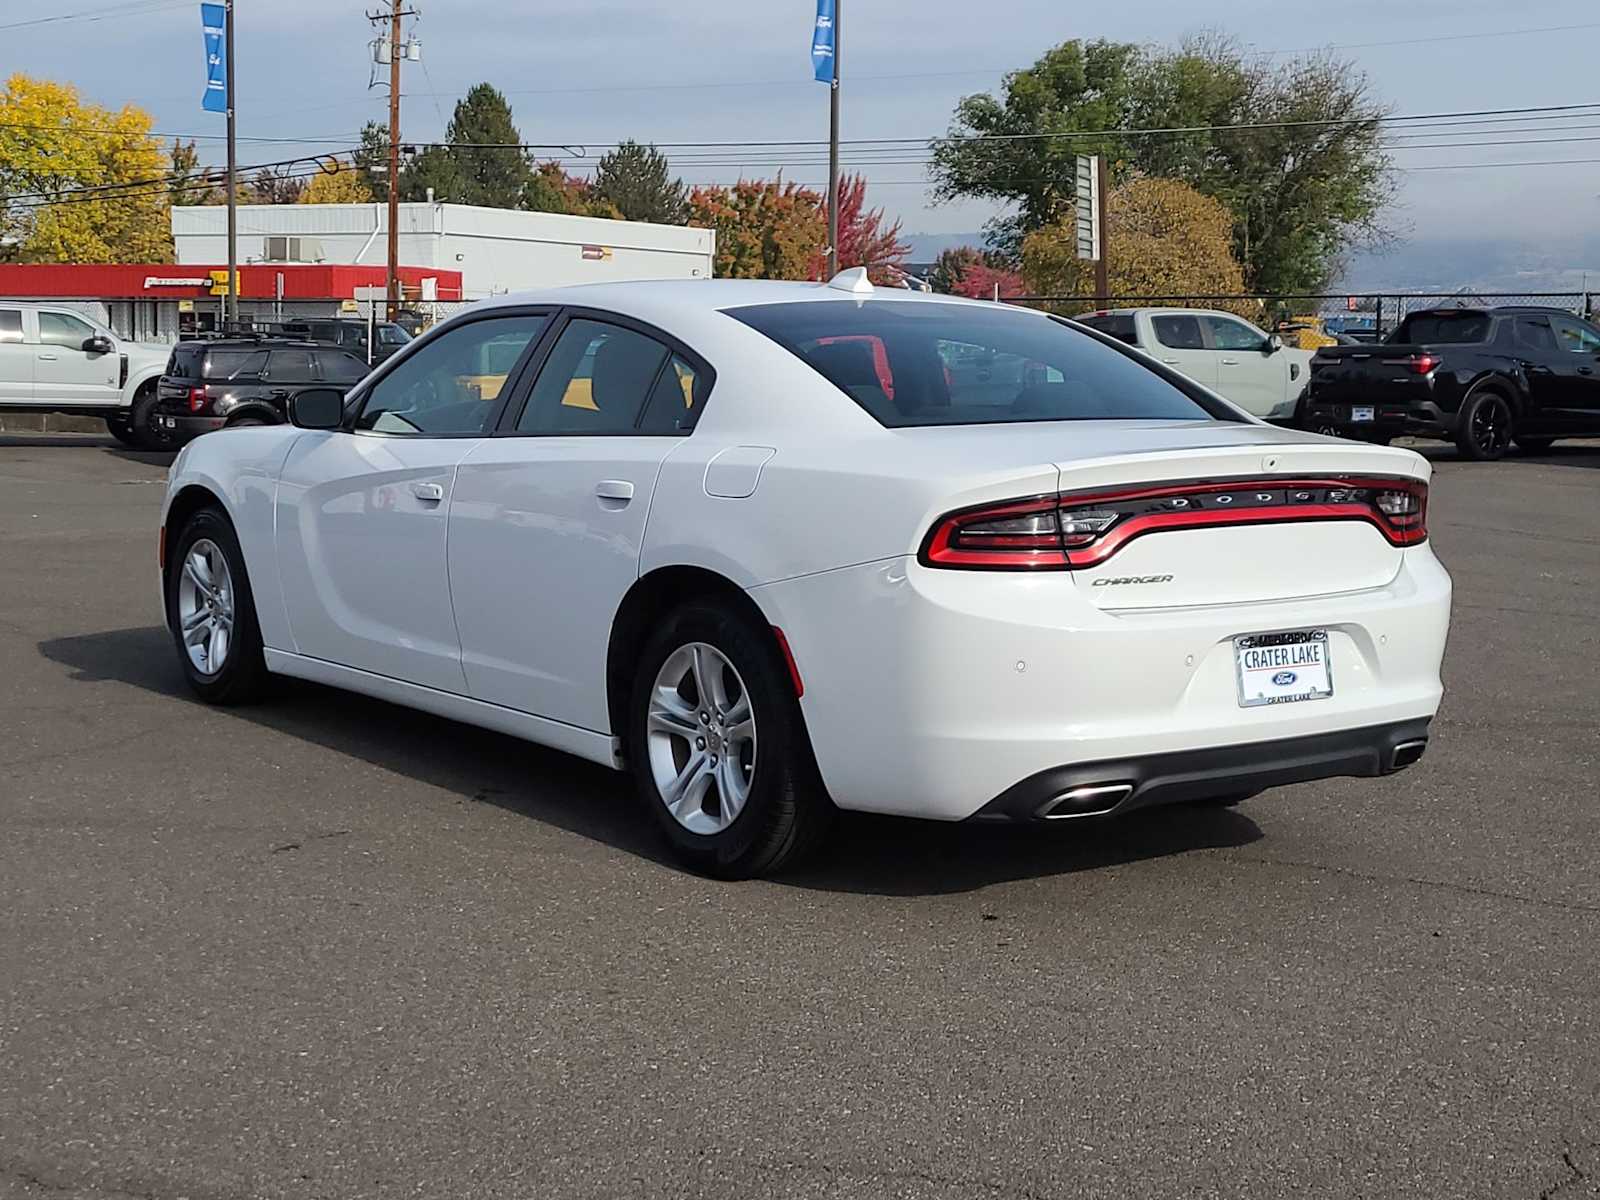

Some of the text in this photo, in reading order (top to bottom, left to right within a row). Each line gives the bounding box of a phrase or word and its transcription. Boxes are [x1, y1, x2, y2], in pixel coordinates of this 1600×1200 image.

[1172, 491, 1346, 507] DODGE
[1092, 574, 1174, 586] CHARGER
[1244, 645, 1320, 669] CRATER LAKE
[1274, 673, 1294, 684] Ford
[1267, 693, 1311, 704] CRATER LAKE
